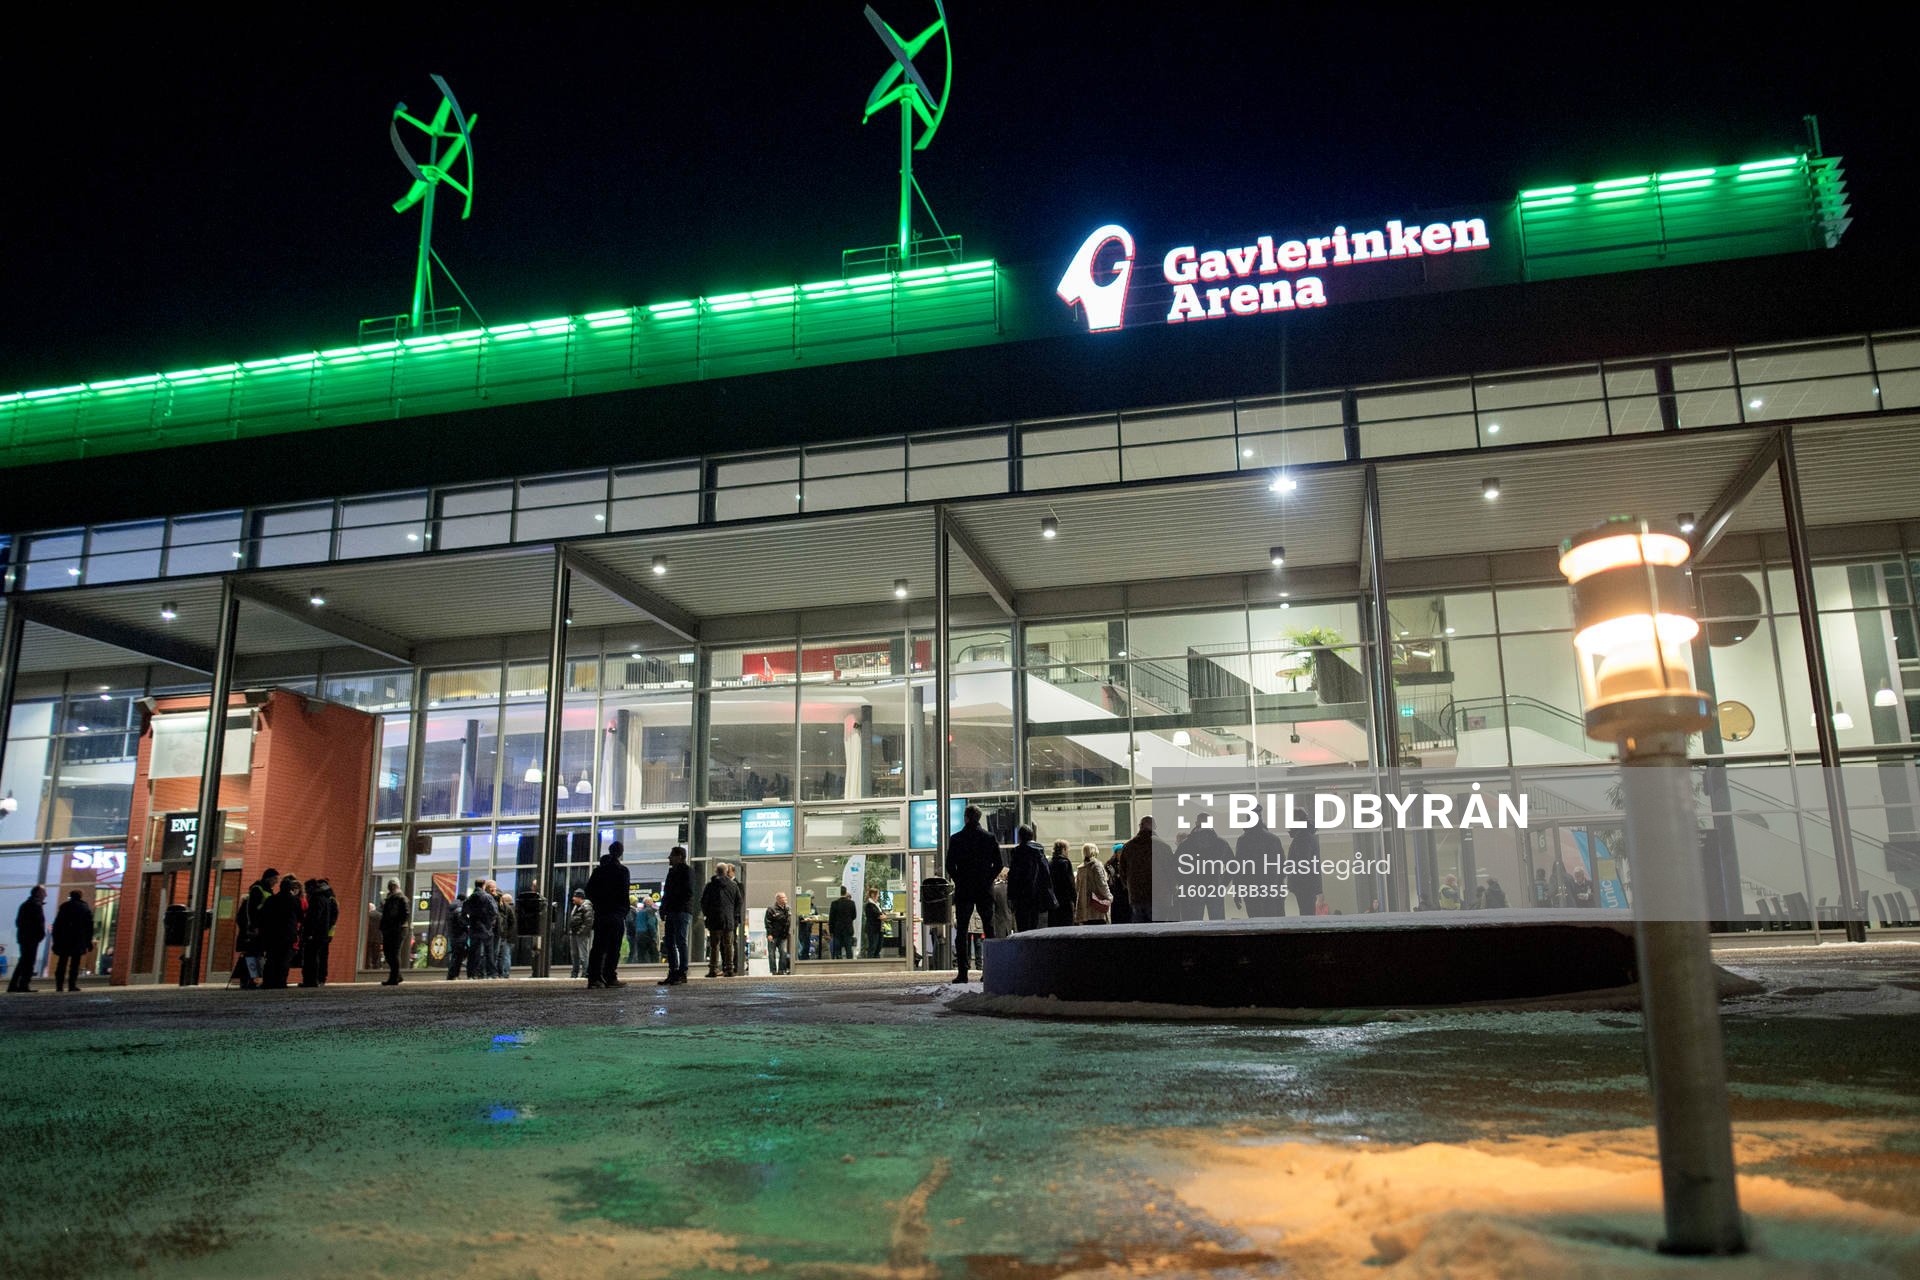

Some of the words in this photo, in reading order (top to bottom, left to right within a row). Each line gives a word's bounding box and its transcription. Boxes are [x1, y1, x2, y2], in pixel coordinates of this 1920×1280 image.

[1163, 216, 1490, 284] Gavlerinken
[1166, 275, 1327, 323] Arena
[170, 817, 199, 832] ENT
[183, 834, 197, 857] 3
[759, 830, 776, 852] 4
[1538, 834, 1546, 848] 6
[1601, 880, 1619, 908] unic
